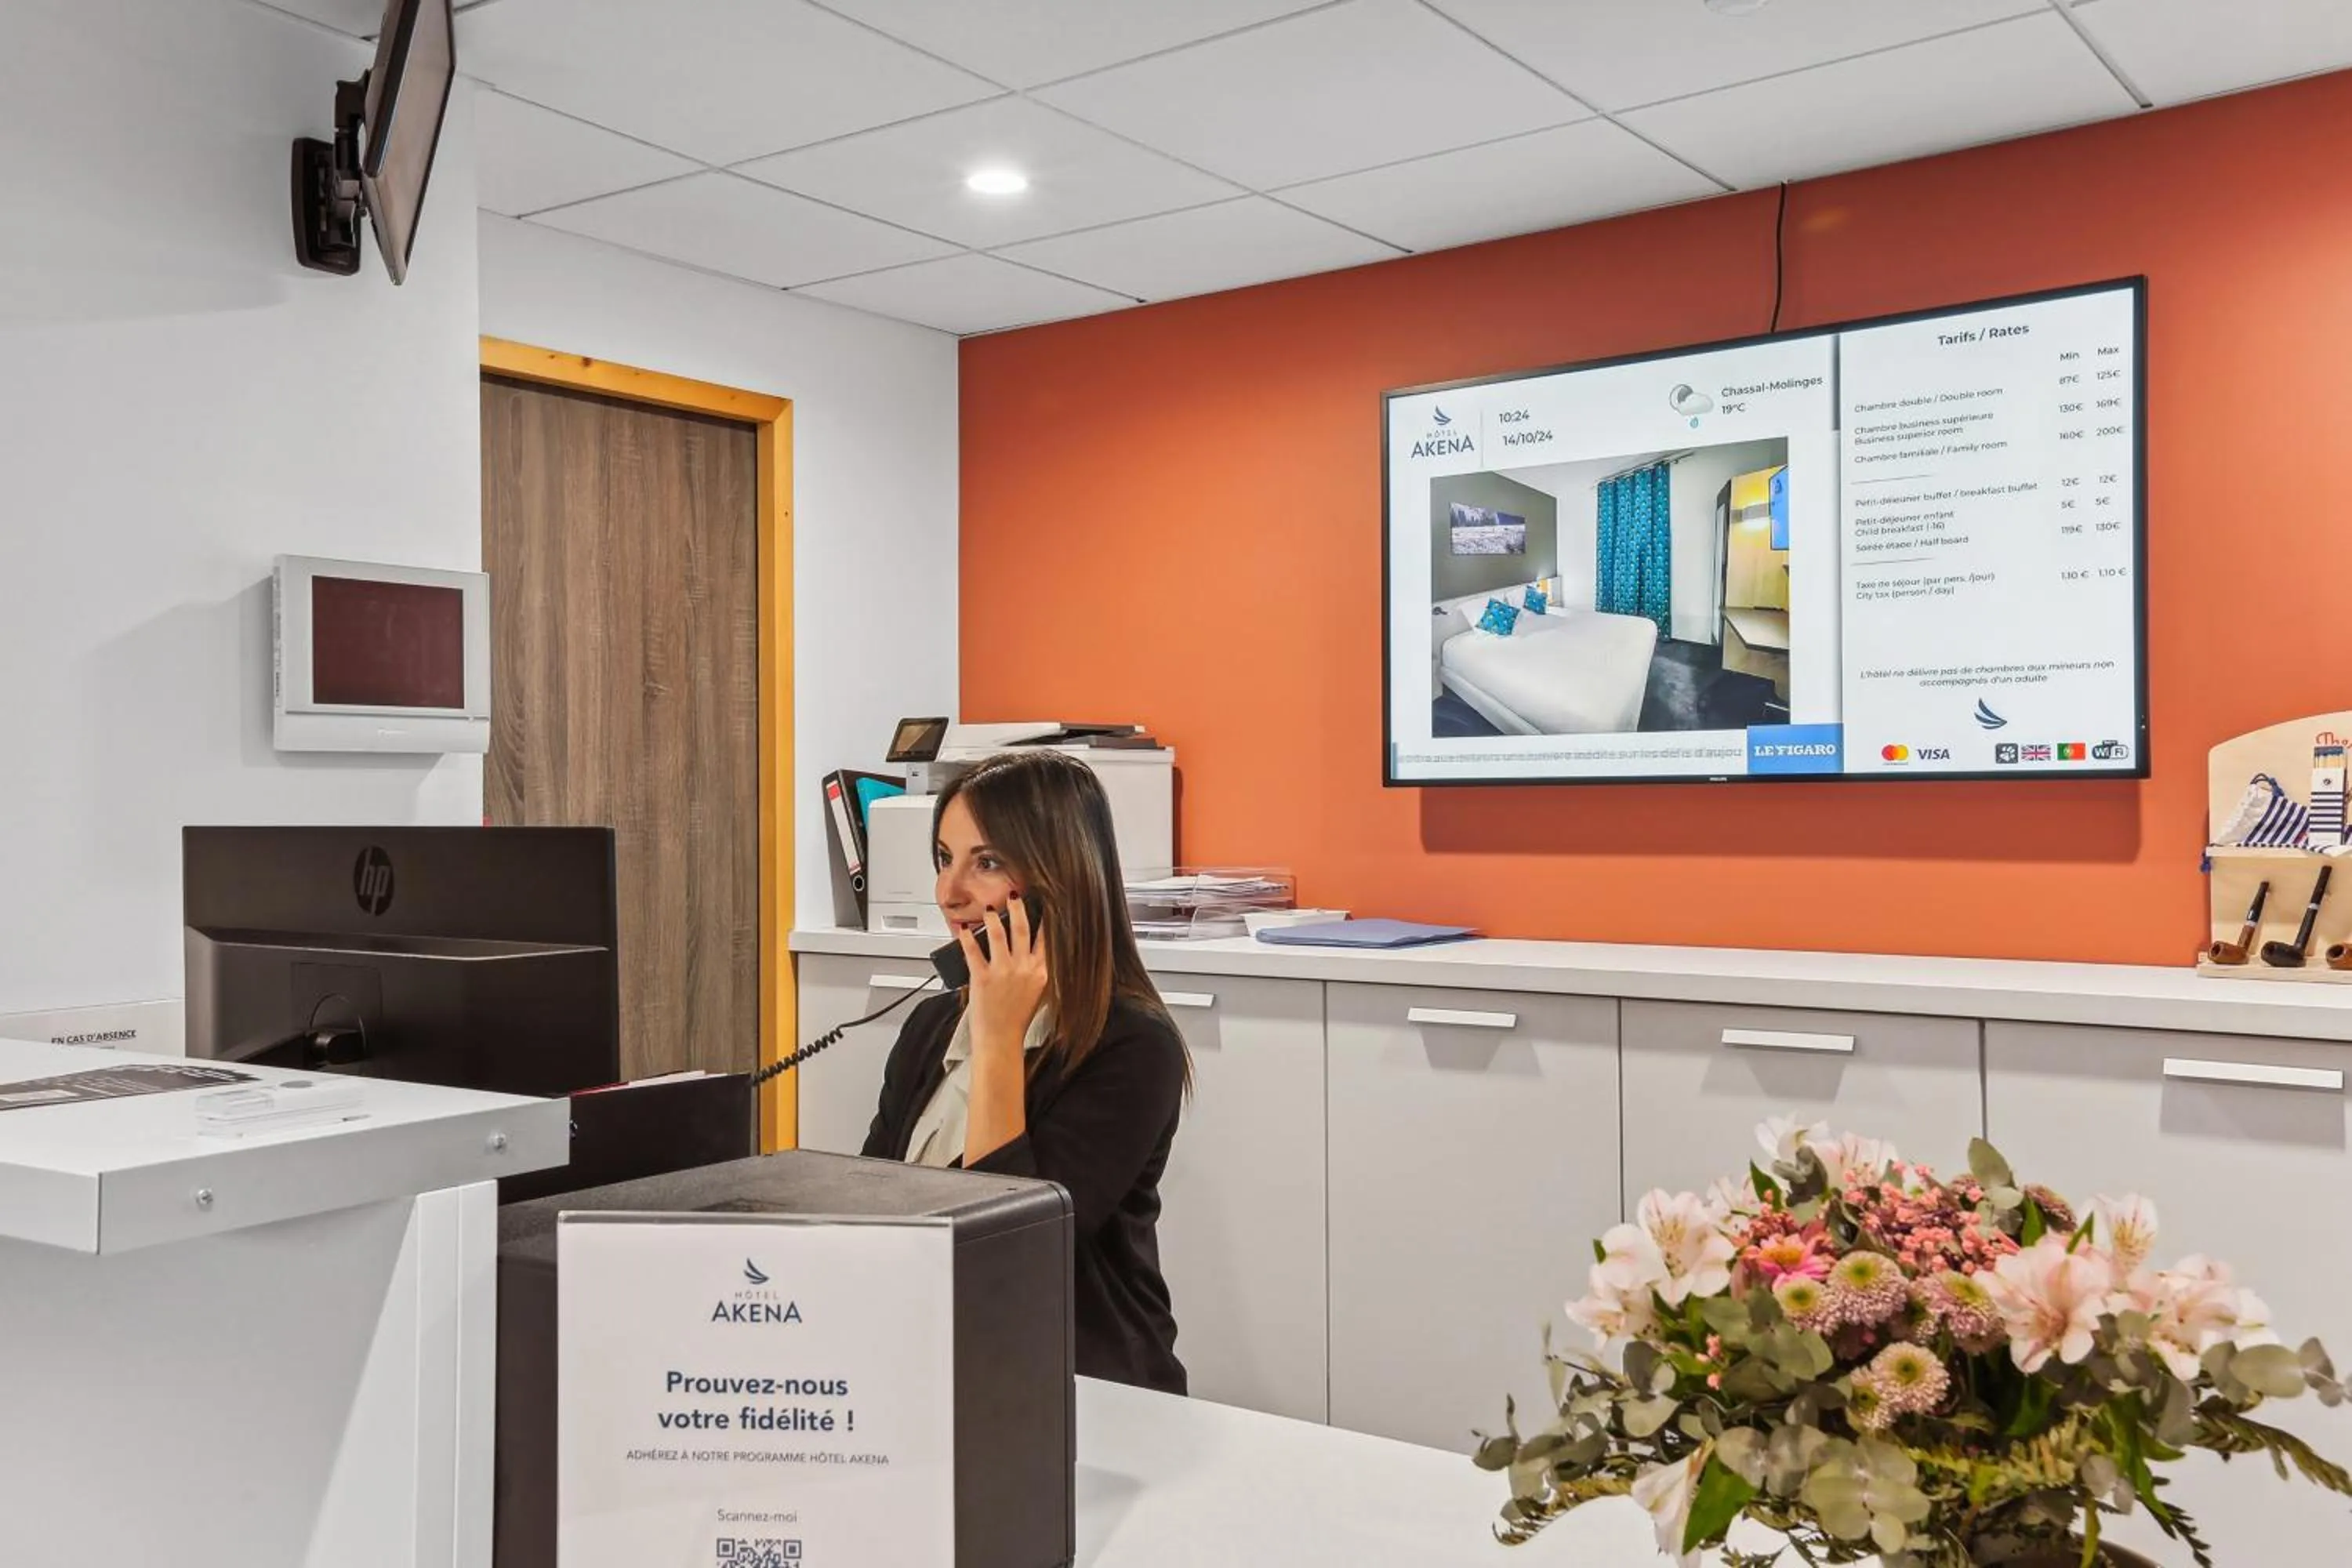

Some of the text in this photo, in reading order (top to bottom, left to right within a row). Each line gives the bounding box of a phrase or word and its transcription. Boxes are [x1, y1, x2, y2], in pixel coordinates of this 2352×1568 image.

[1938, 325, 2029, 345] Tarifs / Rates
[2060, 347, 2119, 361] Min Max
[2059, 369, 2121, 384] 87€ 125€
[1721, 376, 1823, 397] Chassal-Molinges
[1854, 401, 1896, 412] Chambre
[1899, 396, 1932, 407] double
[1940, 390, 1975, 402] Double
[1976, 388, 2003, 397] room
[1722, 402, 1745, 414] 19°C
[2060, 403, 2083, 413] 130€
[1499, 409, 1530, 423] 10:24
[1854, 412, 1994, 434] Chambre business supérieure
[1426, 430, 1457, 438] HÔTEL
[1503, 430, 1553, 446] 14/10/24
[1854, 426, 1964, 445] Business superior room
[2059, 426, 2125, 440] 160€ 200€
[1410, 434, 1475, 459] AKENA
[1854, 452, 1897, 463] Chambre
[1947, 442, 1979, 453] Family
[1981, 441, 2007, 449] room
[2061, 474, 2118, 487] 12€ 12€
[1855, 494, 1920, 507] Petit-déjeuner
[1923, 491, 1952, 501] buffet
[1959, 485, 2005, 496] breakfast
[2008, 482, 2038, 492] buffet
[2061, 496, 2111, 509] 5€ 5€
[1855, 510, 1955, 526] Petit-déjeuner enfant
[1855, 527, 1879, 537] Child
[1881, 524, 1923, 535] breakfast
[2095, 521, 2121, 531] 130€
[1855, 542, 1884, 552] Soirée
[1920, 538, 1939, 546] Half
[1940, 535, 1969, 545] board
[2118, 567, 2127, 575] €
[1856, 580, 1875, 589] Taxe
[1878, 579, 1889, 587] de
[1892, 578, 1920, 589] séjour
[1923, 576, 1940, 586] (par
[1856, 591, 1872, 601] City
[1892, 588, 1926, 598] (person
[1934, 586, 1955, 596] day)
[1907, 667, 1939, 677] délivre
[1940, 667, 1958, 677] pas
[1959, 666, 1973, 674] de
[1975, 663, 2025, 674] chambres
[2049, 661, 2091, 670] mineurs
[2092, 660, 2115, 669] non
[1919, 677, 1987, 688] accompagnés
[1991, 674, 2013, 684] d'un
[1754, 744, 1835, 757] LE FIGARO
[1918, 749, 1950, 760] VISA
[67, 1035, 85, 1044] CAS
[86, 1029, 137, 1042] D'ABSENCE
[735, 1290, 779, 1300] HÔTEL
[711, 1301, 803, 1323] AKENA
[666, 1370, 848, 1396] Prouvez-nous
[658, 1406, 855, 1432] votre fidélité !
[626, 1448, 889, 1465] ADHÉREZ À NOTRE PROGRAMME HÔTEL AKENA
[717, 1508, 797, 1523] Scannez-moi
